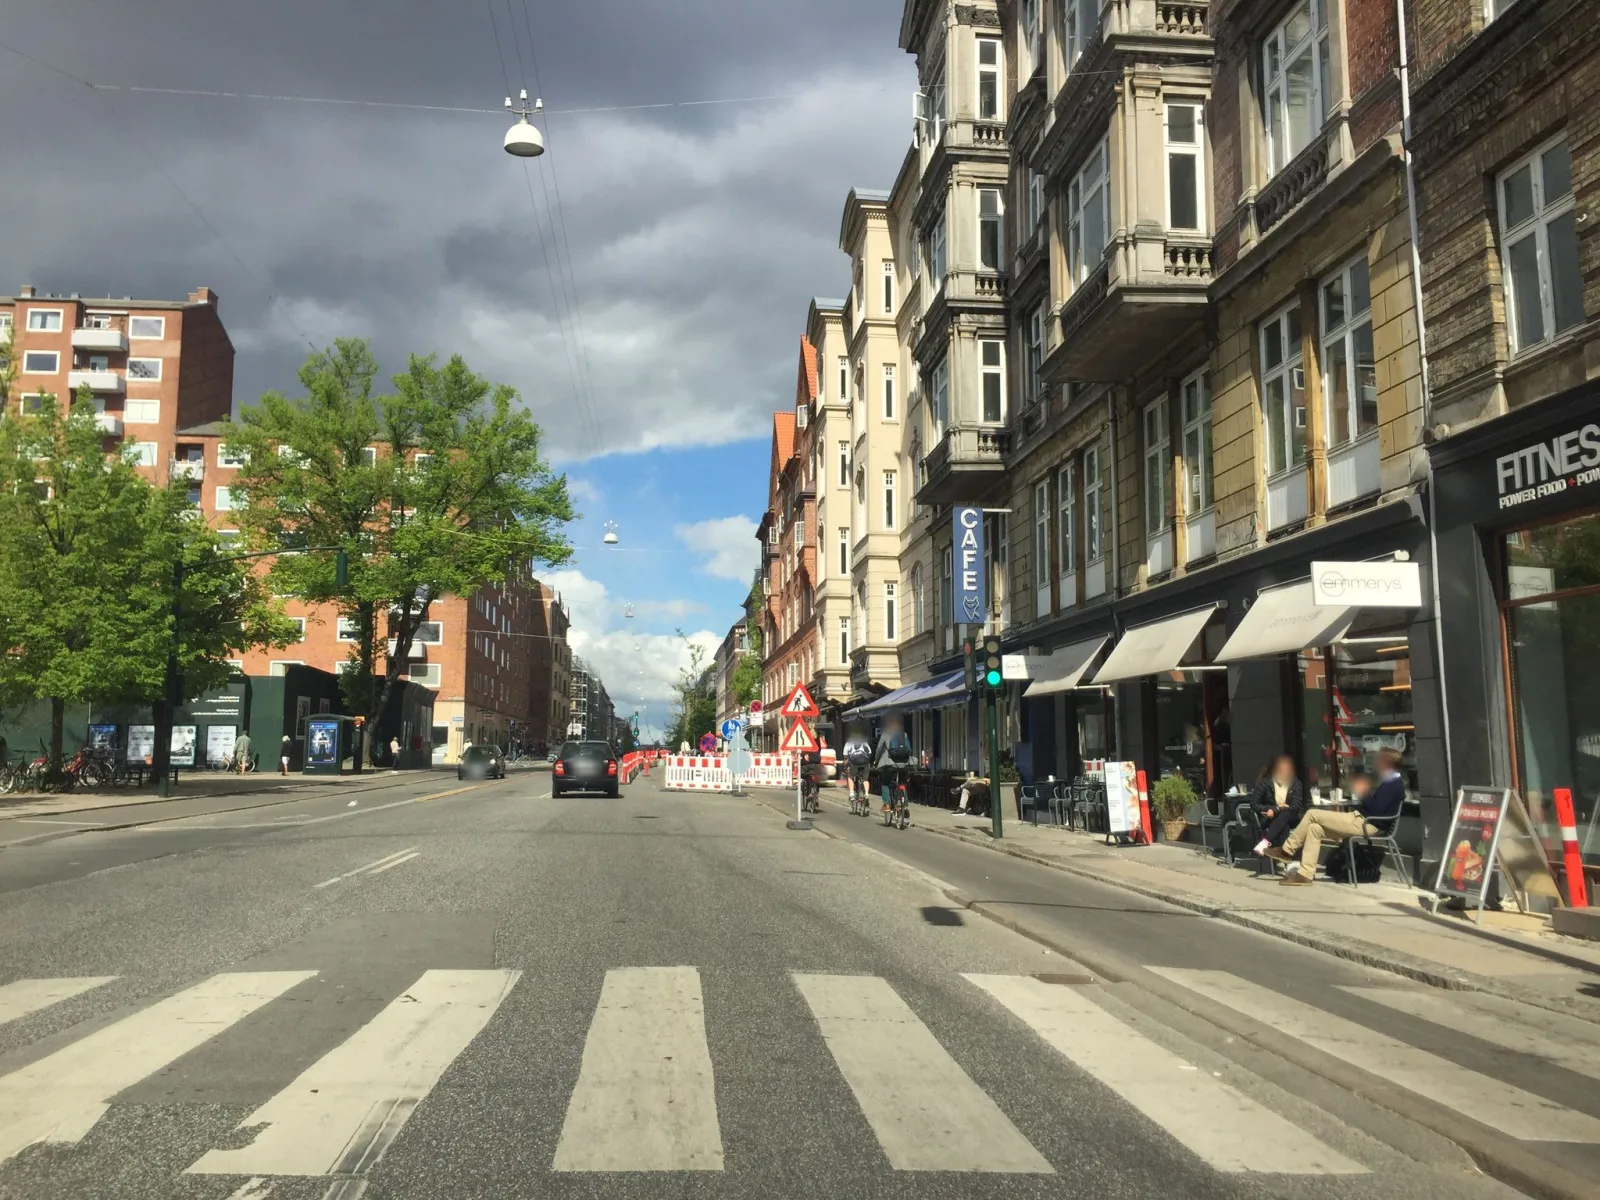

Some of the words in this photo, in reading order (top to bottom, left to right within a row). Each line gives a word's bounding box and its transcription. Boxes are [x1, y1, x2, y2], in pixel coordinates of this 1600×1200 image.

[1499, 489, 1536, 509] POWER
[1537, 478, 1567, 498] FOOD
[961, 509, 978, 591] CAFE
[1321, 576, 1402, 593] emmerys
